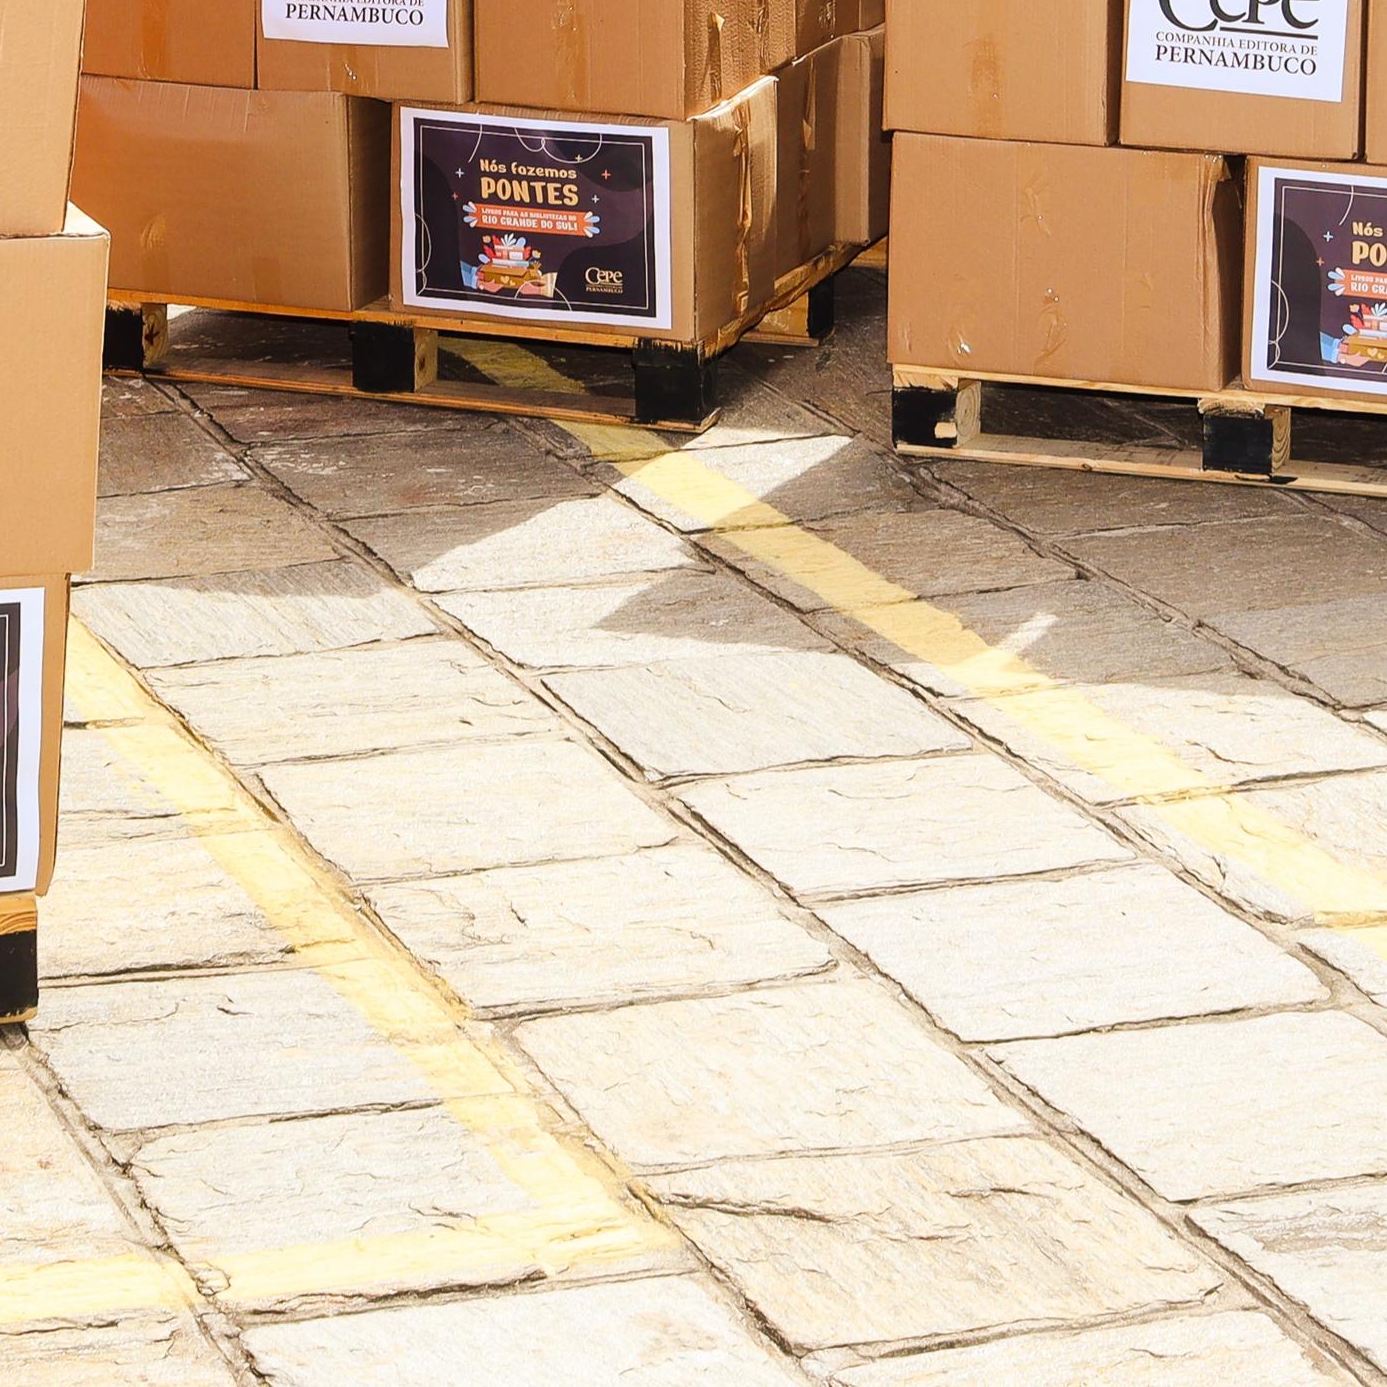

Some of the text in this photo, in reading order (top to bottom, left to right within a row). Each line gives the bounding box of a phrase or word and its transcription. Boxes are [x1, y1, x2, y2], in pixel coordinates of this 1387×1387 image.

[285, 3, 423, 26] PERNAMBUCO
[1156, 31, 1318, 56] COMPANHIA EDITORA DE
[1155, 44, 1317, 76] PERNAMBUCO
[479, 159, 577, 178] Nós fazemos
[479, 177, 579, 206] PONTES
[481, 214, 578, 231] RIO GRANDE DO SUL!
[1352, 221, 1383, 237] Nós
[1350, 281, 1369, 292] RIO
